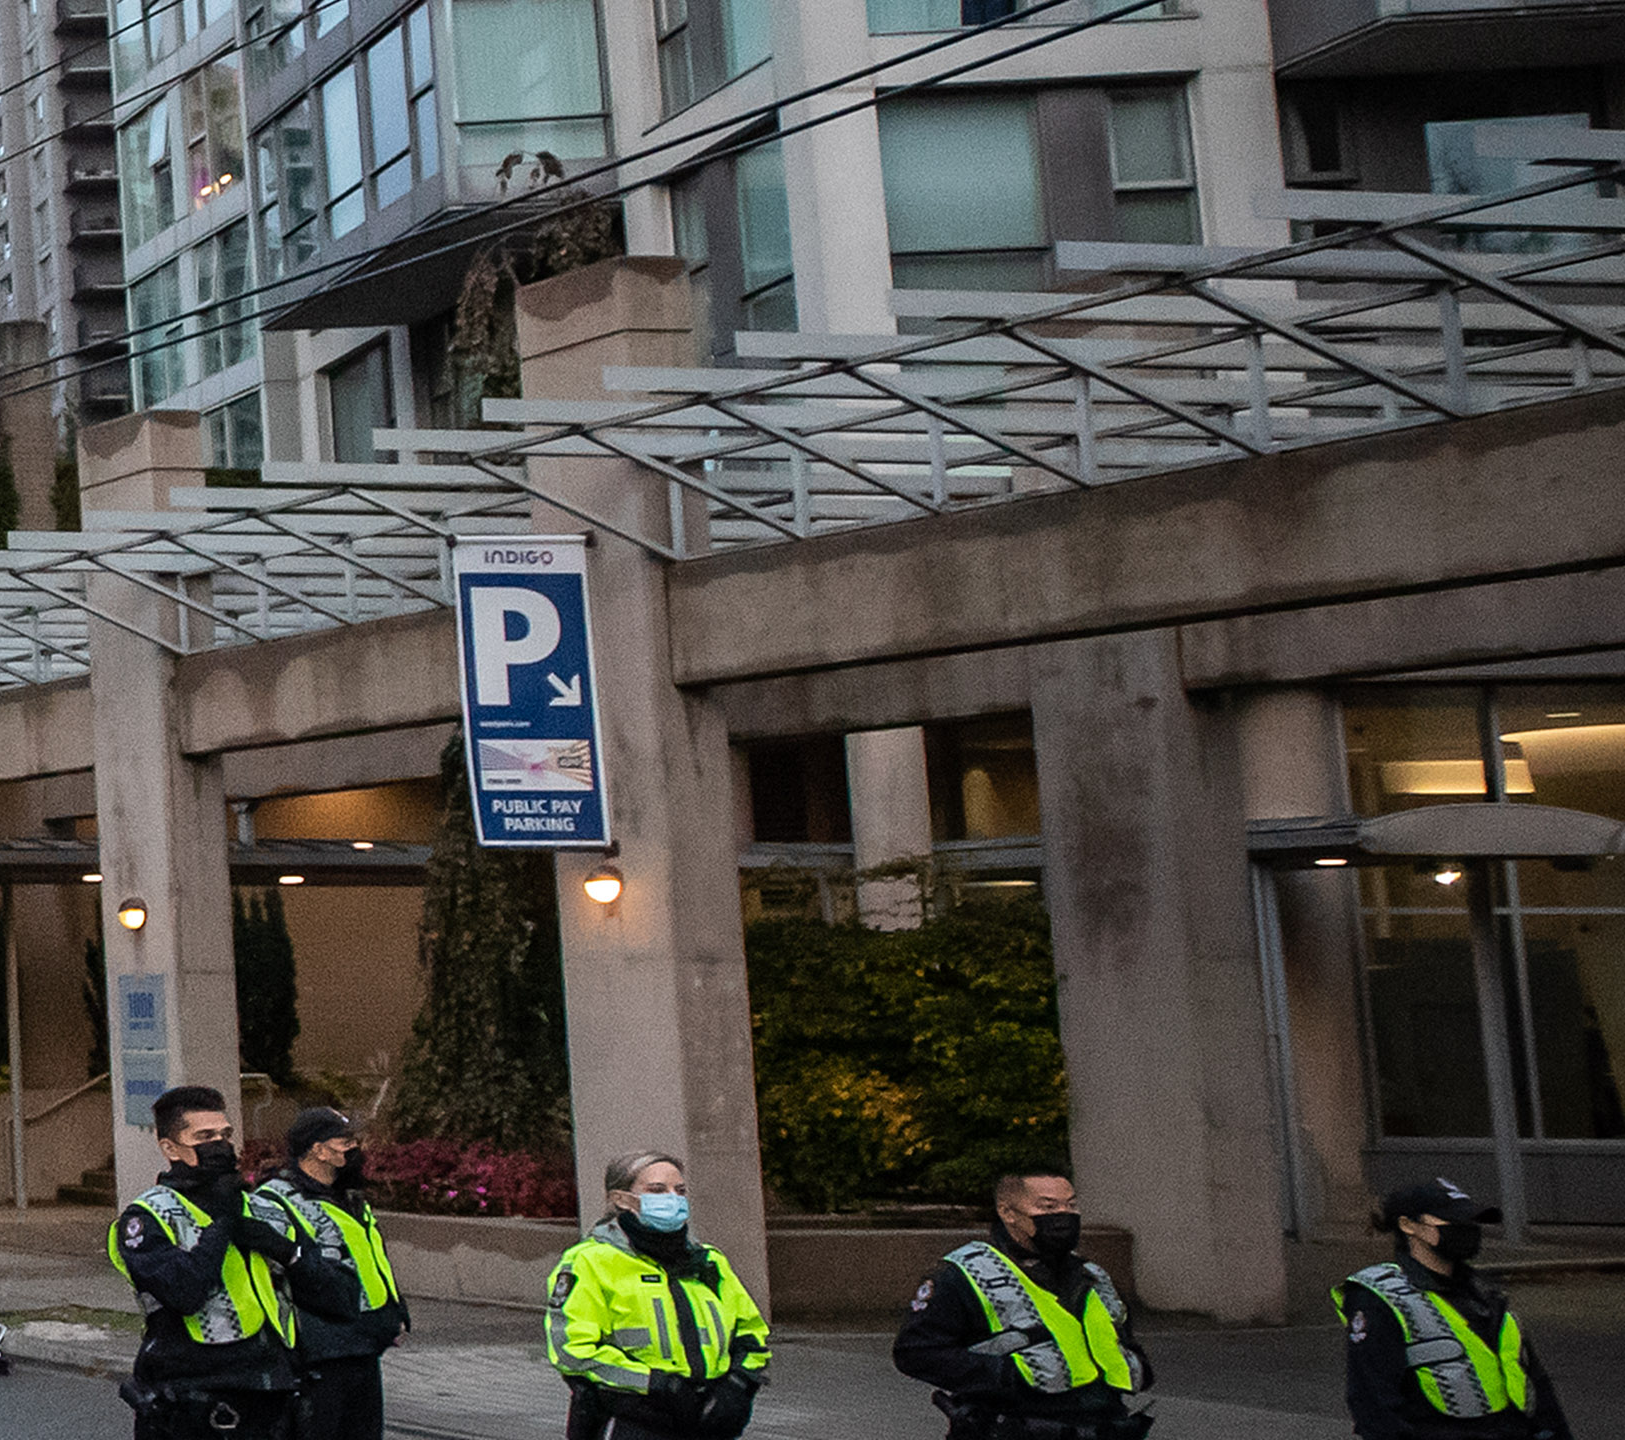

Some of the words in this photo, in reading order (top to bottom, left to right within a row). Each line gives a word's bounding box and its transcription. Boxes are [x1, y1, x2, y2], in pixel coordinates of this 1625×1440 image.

[484, 550, 554, 565] INDIGO
[470, 586, 562, 706] P
[491, 799, 548, 814] PUBLIC
[551, 799, 583, 815] PAY
[504, 816, 575, 832] PARKING
